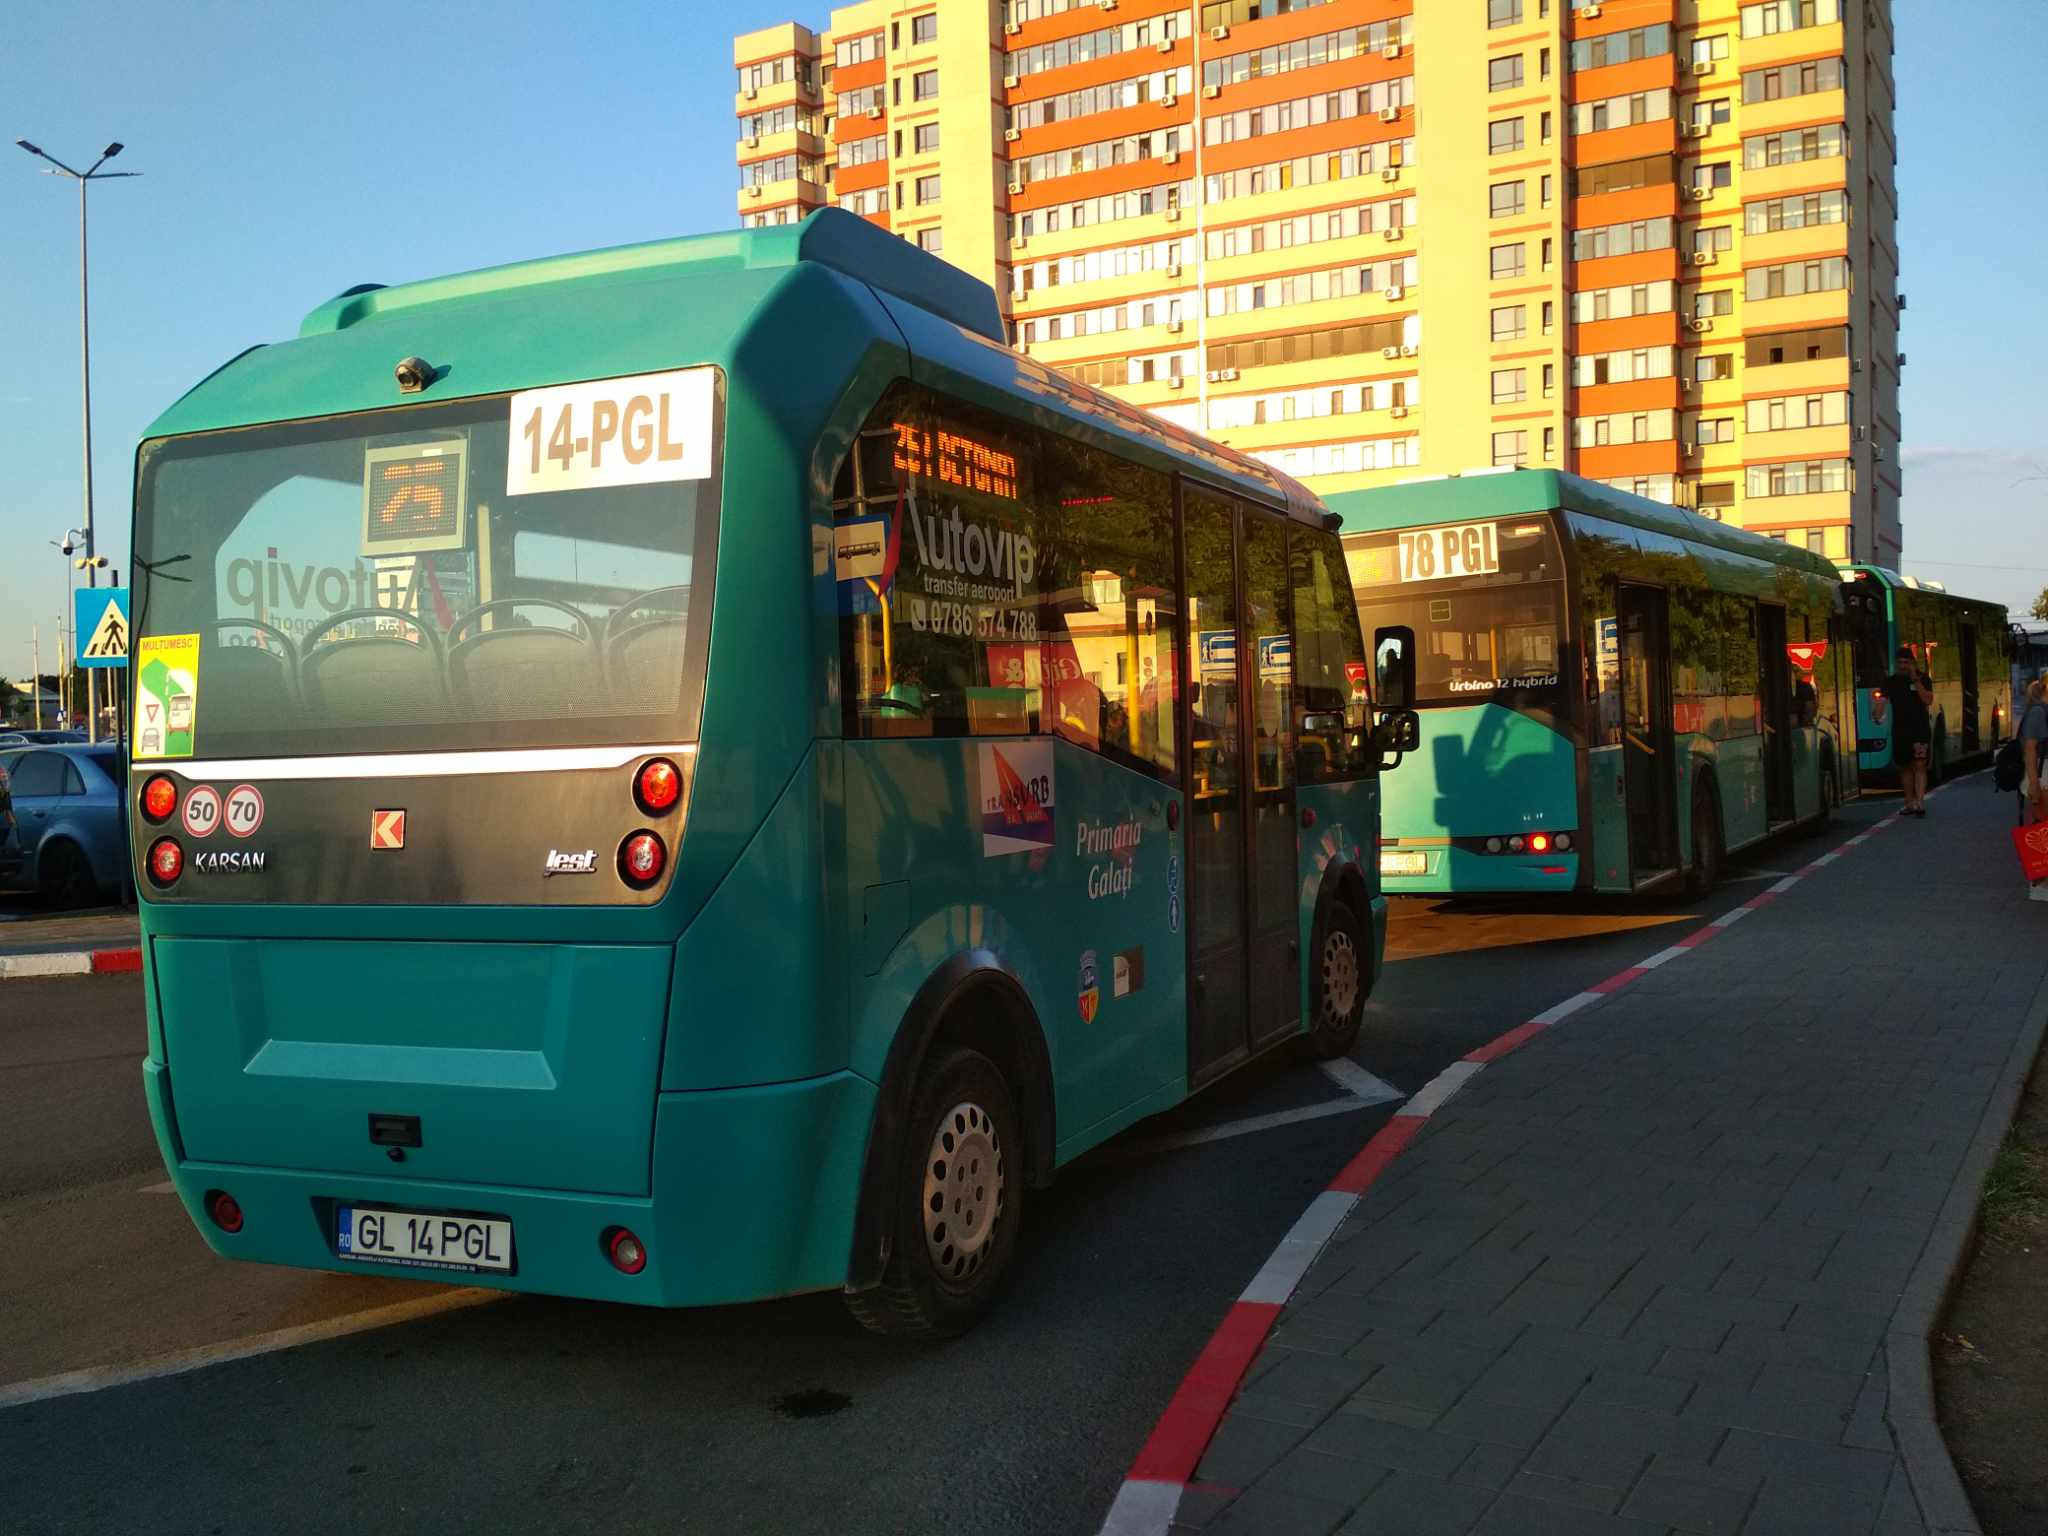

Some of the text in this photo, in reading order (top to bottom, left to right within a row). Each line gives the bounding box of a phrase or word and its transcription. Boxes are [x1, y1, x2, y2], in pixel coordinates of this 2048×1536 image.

[524, 392, 684, 475] 14-PGL
[1399, 532, 1436, 579] 78
[1441, 526, 1497, 576] PGL
[923, 573, 1016, 604] transfer aeroport
[930, 599, 1038, 642] 0786 574 788
[1449, 674, 1558, 693] Urbino 12 hybrid
[189, 800, 215, 822] 50
[231, 800, 257, 822] 70
[194, 851, 266, 873] KARSAN
[338, 1232, 351, 1249] RO
[358, 1214, 395, 1253] GL
[408, 1217, 434, 1256] 14
[440, 1220, 502, 1263] PGL
